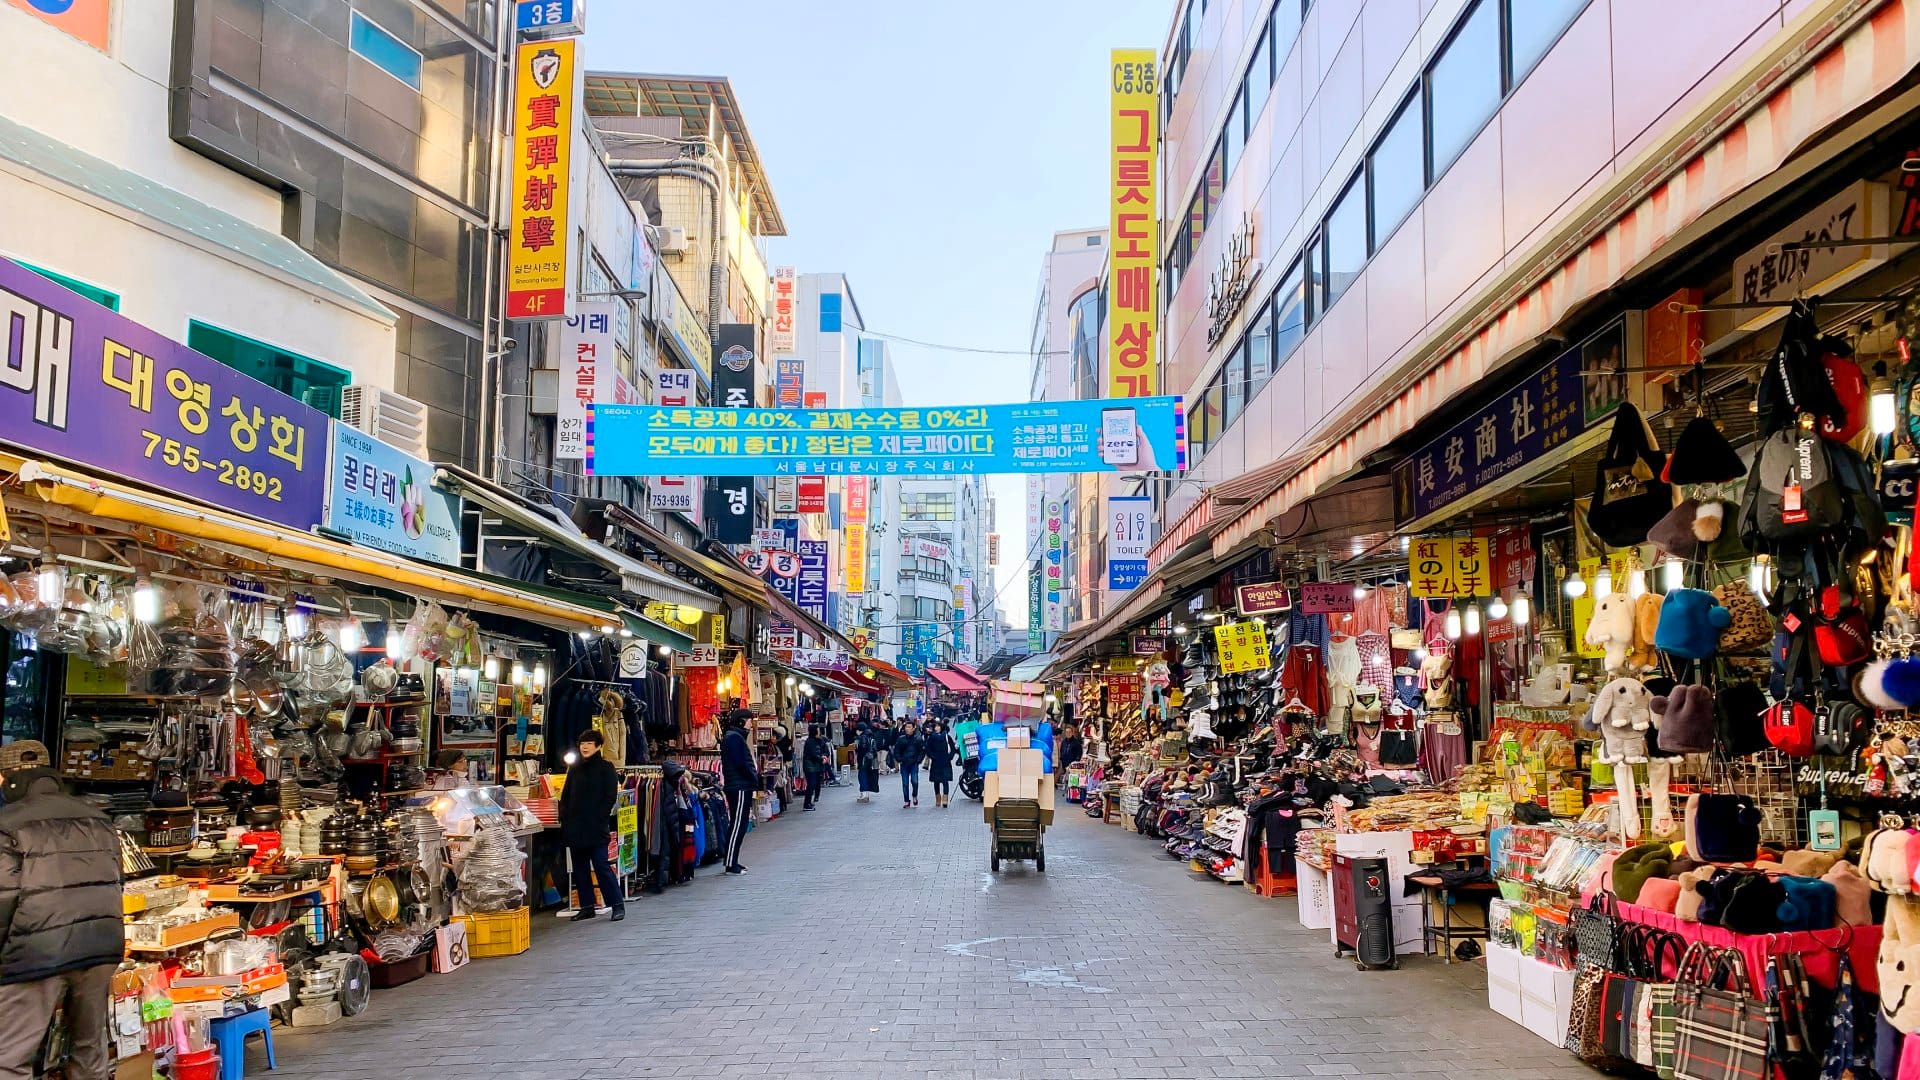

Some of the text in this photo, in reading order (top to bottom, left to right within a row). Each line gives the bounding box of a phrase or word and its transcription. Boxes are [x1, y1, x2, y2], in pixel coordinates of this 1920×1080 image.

[531, 4, 563, 25] 3층
[522, 94, 560, 252] 實彈射擊
[1115, 109, 1152, 398] 그릇도매상가
[525, 295, 547, 312] 4F
[776, 282, 793, 332] 부동산
[566, 314, 608, 334] 이레
[659, 373, 689, 389] 현대
[101, 335, 306, 472] 대영상회
[560, 419, 582, 429] 상가
[648, 409, 737, 428] 소득공제
[808, 411, 921, 430] 결제수수료
[926, 408, 988, 429] 0%라
[560, 432, 582, 442] 임대
[1012, 424, 1057, 434] 소득공제
[648, 434, 994, 455] 모두에게 좋다! 정답은 제로페이다
[1418, 389, 1537, 497] 長安商社
[141, 429, 283, 502] 755-2892
[1795, 437, 1815, 481] Supreme
[343, 453, 396, 506] 꿀타래
[652, 494, 690, 507] 753-9396
[755, 531, 781, 541] 동산
[1117, 546, 1144, 554] TOILET
[1418, 577, 1483, 595] キムチ
[1218, 624, 1261, 639] 안전화
[769, 636, 795, 648] 안경
[1220, 634, 1263, 650] 주방화
[1222, 645, 1264, 661] 장화
[1224, 656, 1267, 672] 댄스화
